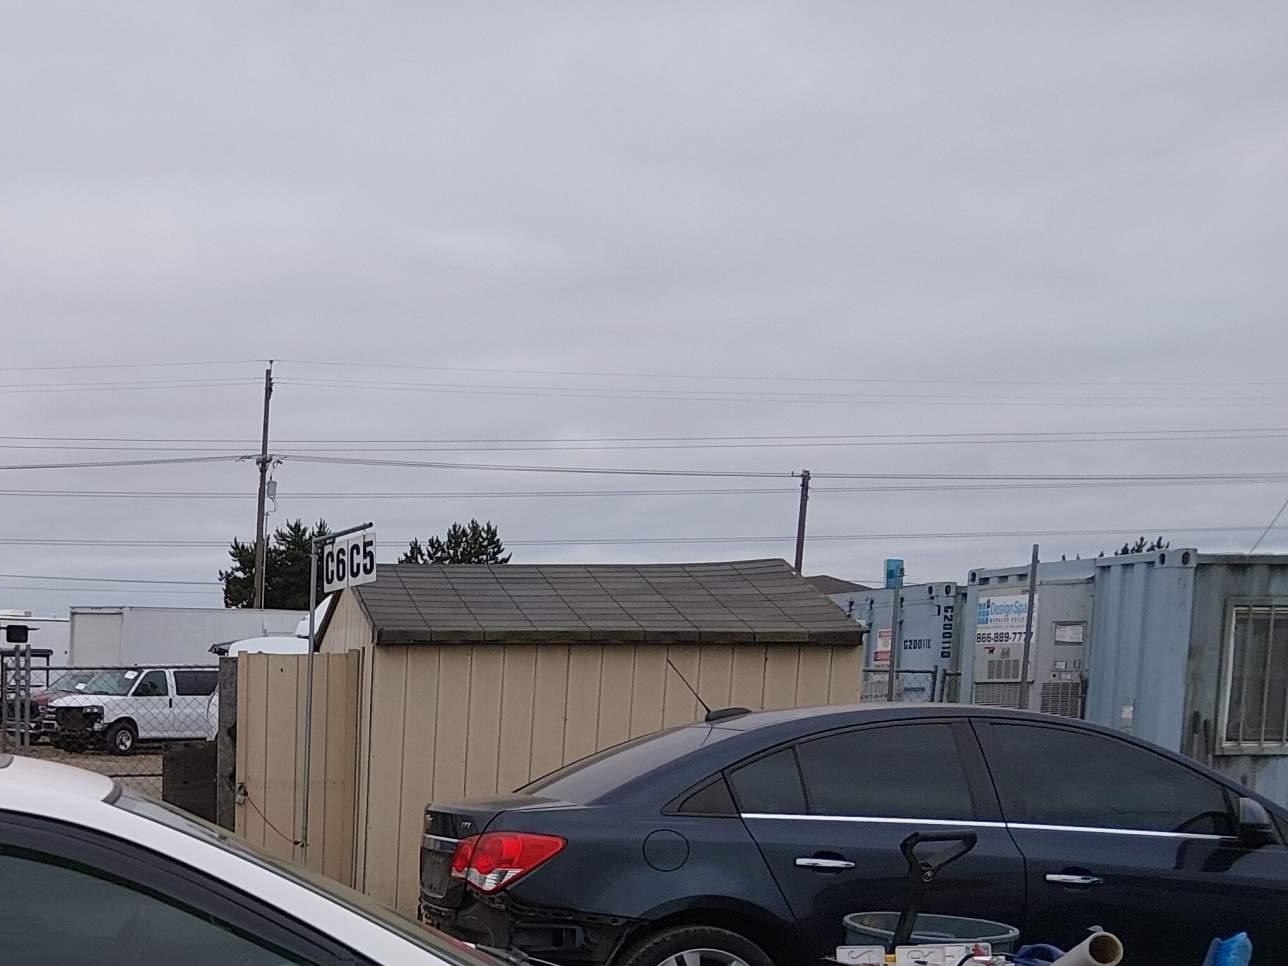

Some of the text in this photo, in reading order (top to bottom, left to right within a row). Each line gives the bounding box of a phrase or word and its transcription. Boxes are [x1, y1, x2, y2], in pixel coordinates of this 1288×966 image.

[325, 540, 374, 585] C6 C5
[940, 605, 954, 658] G200110
